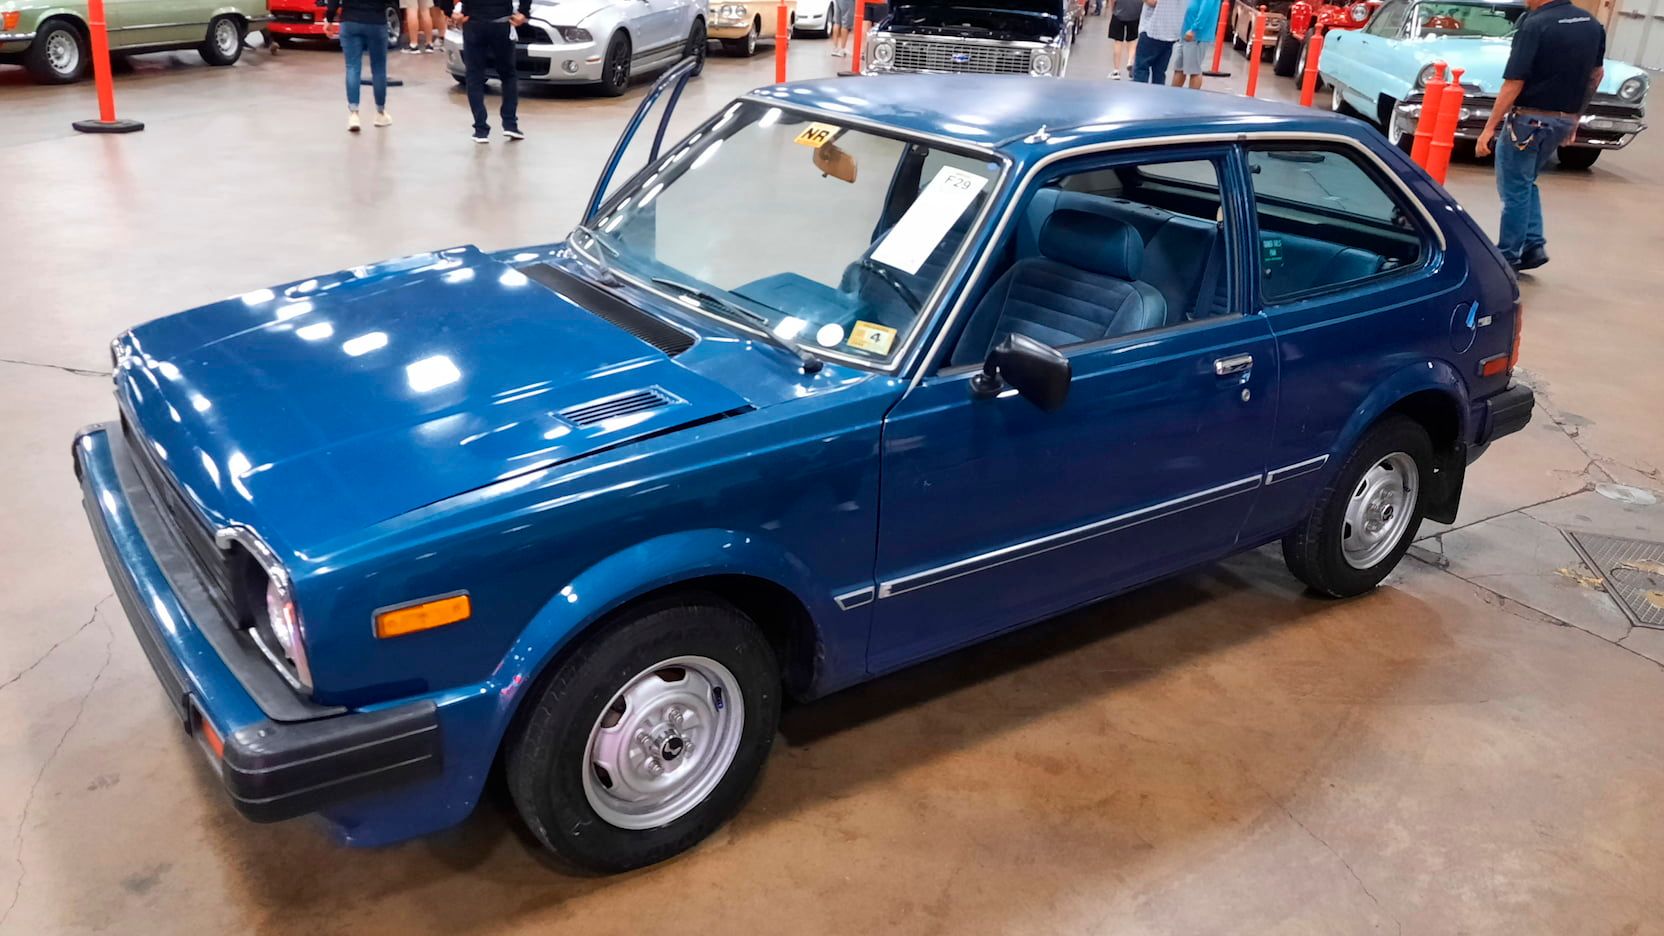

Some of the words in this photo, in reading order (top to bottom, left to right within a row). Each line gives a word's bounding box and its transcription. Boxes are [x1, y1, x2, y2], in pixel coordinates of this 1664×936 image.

[801, 127, 830, 142] NR
[945, 175, 972, 190] F29
[870, 333, 881, 343] 4
